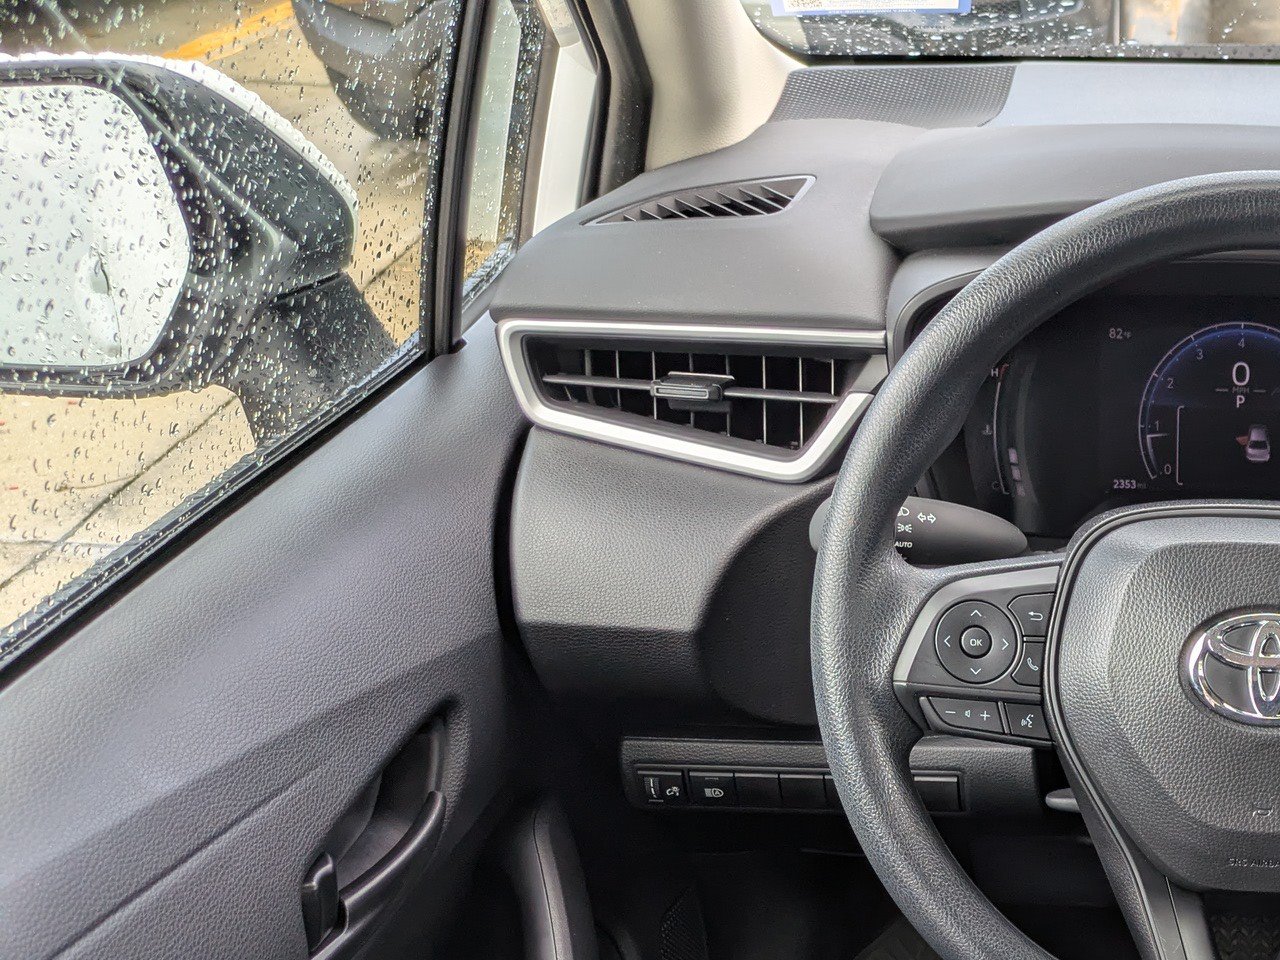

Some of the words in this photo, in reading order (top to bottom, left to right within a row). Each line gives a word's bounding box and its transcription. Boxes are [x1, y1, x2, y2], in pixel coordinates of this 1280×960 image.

[1238, 338, 1245, 348] 4
[1196, 350, 1203, 360] 3
[990, 368, 999, 377] H
[1232, 361, 1250, 386] 0
[1167, 378, 1174, 389] 2
[1236, 395, 1245, 408] P
[1155, 420, 1160, 431] 1
[1164, 464, 1172, 474] 0
[1113, 479, 1136, 489] 2353
[970, 639, 982, 647] OK
